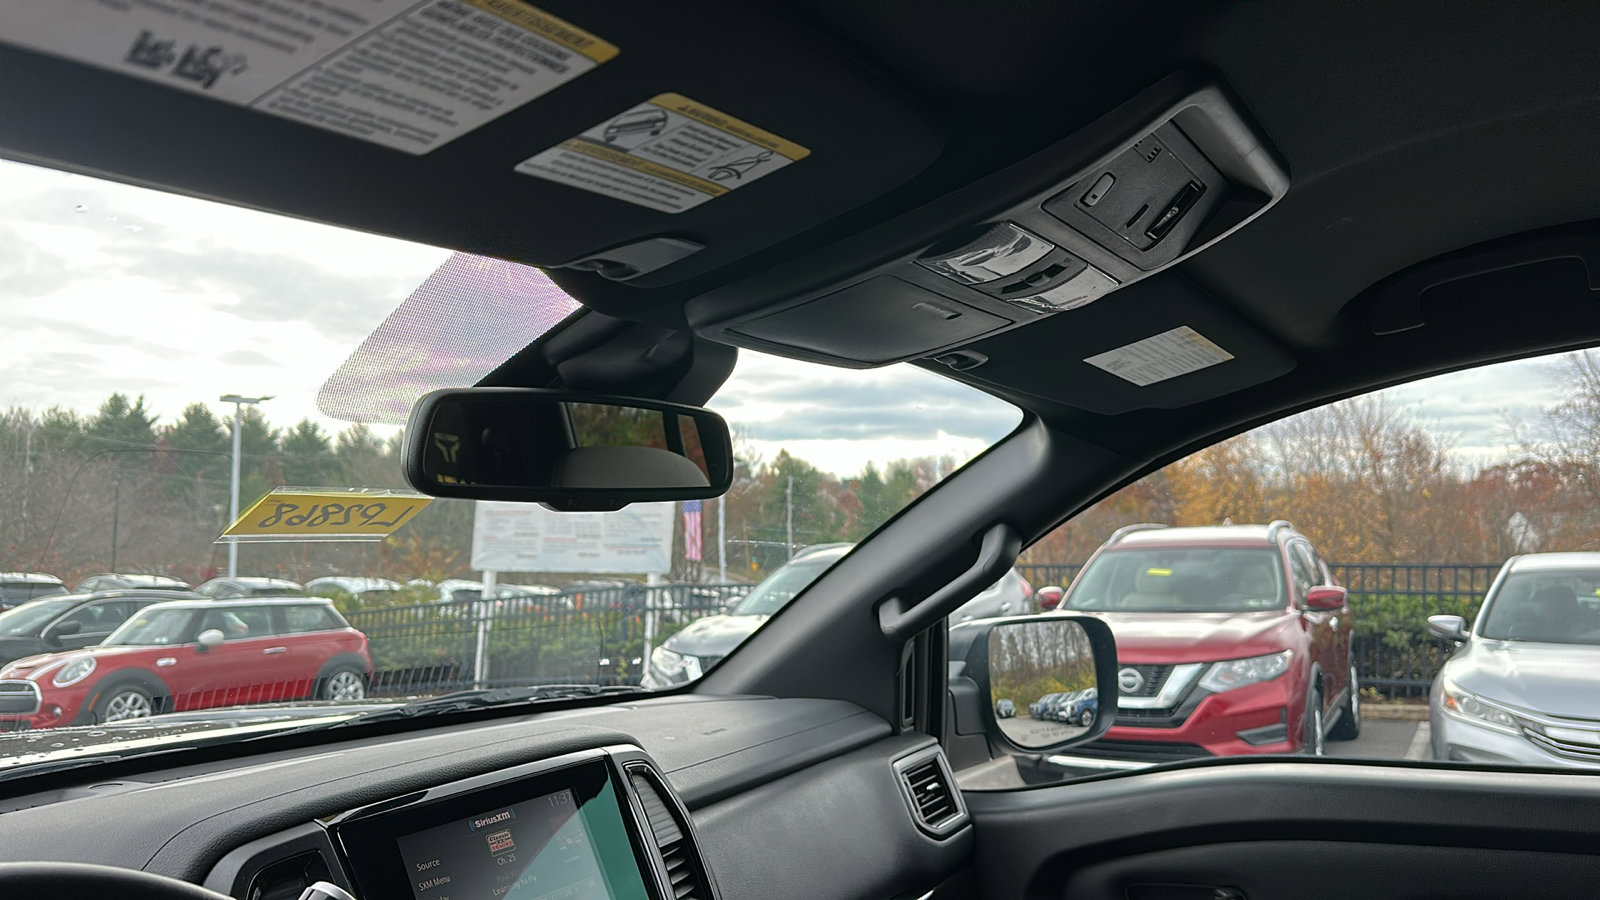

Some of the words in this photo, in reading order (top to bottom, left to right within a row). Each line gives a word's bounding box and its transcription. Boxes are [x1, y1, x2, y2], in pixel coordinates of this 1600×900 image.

[416, 859, 441, 872] Source
[418, 880, 434, 892] SXM
[433, 876, 451, 887] Menu
